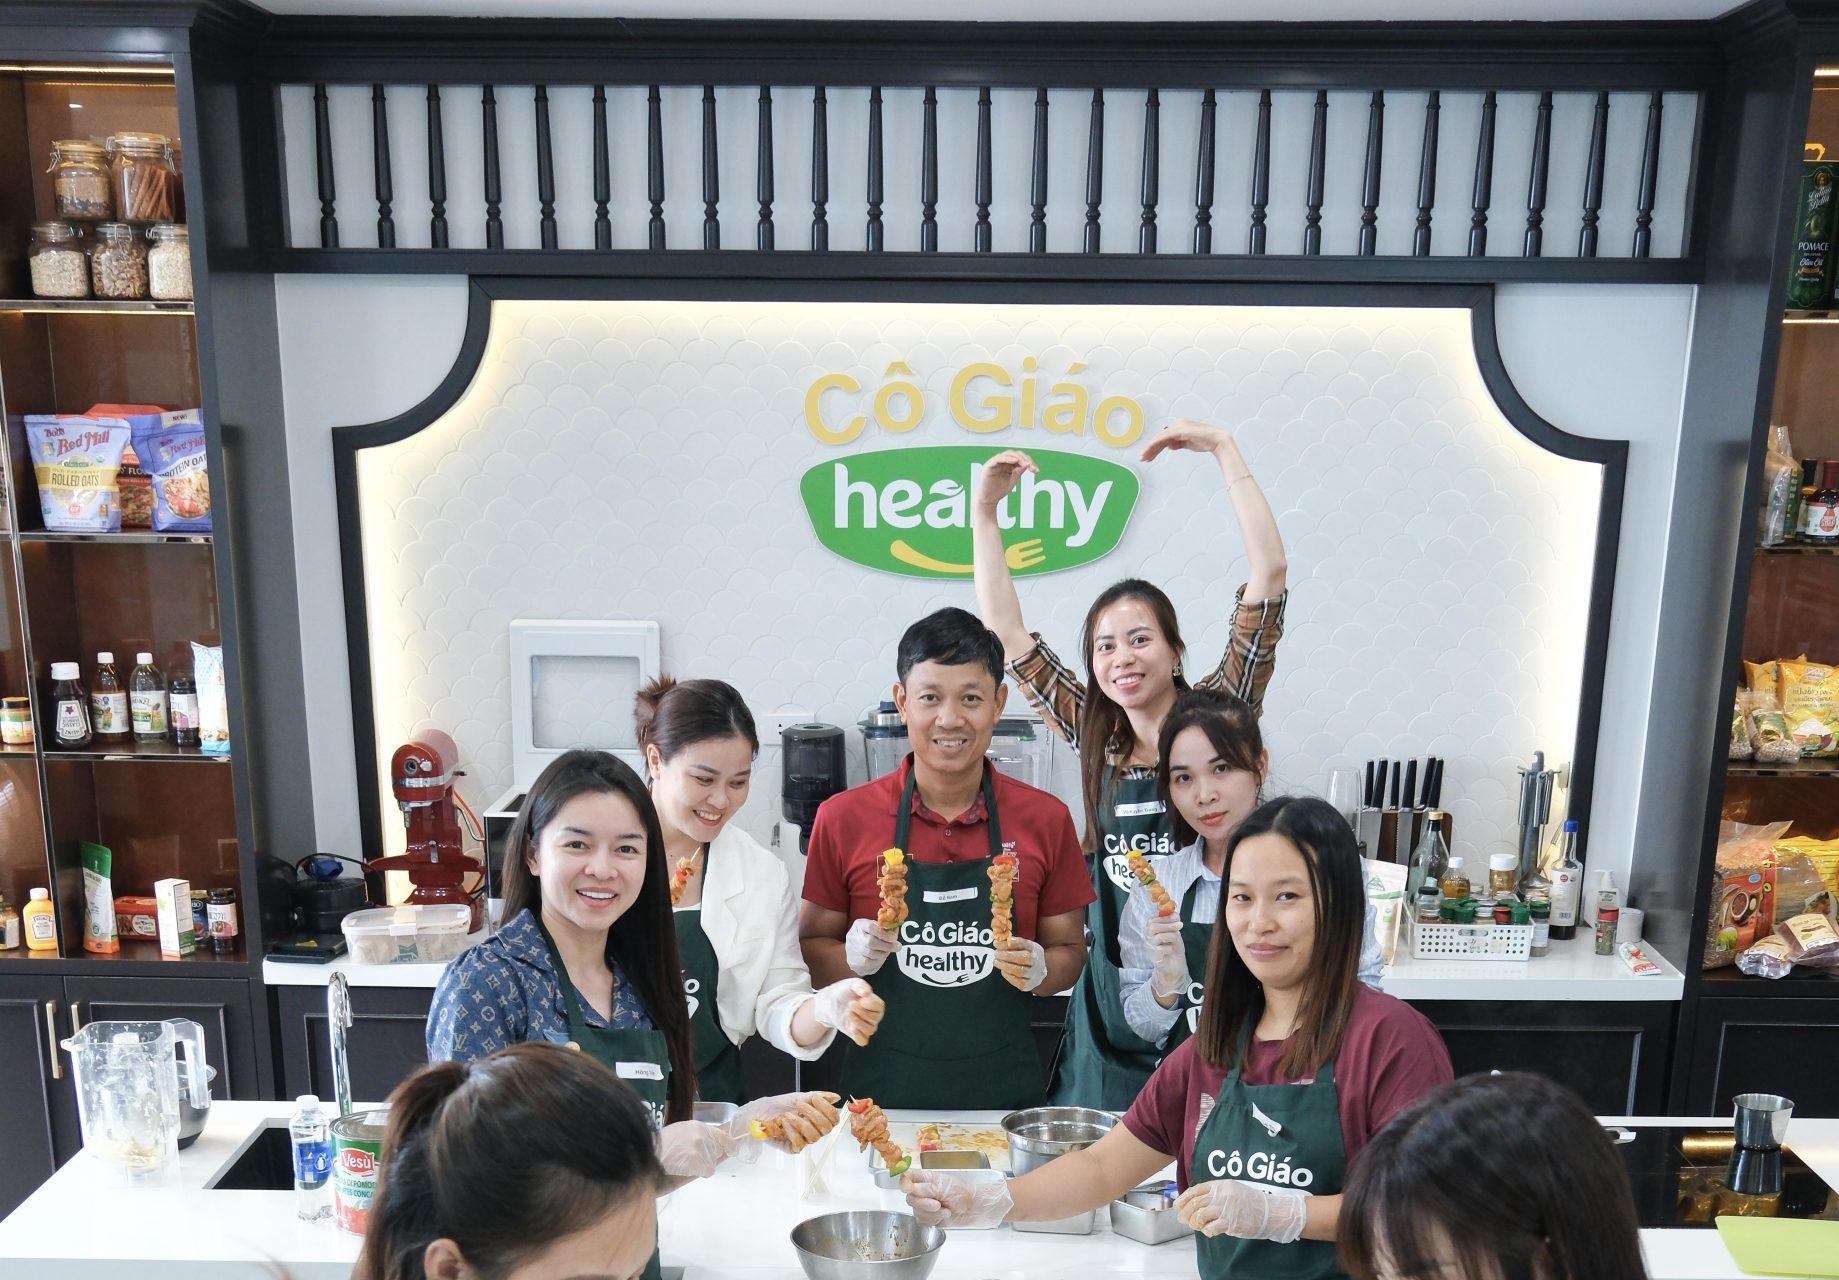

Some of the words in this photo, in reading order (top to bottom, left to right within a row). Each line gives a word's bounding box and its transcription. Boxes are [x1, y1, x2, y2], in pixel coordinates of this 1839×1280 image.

[1798, 242, 1830, 251] POMACE
[803, 360, 925, 446] Cô
[949, 355, 1145, 448] Giáo
[57, 434, 83, 457] Red
[84, 429, 110, 452] Mill
[192, 454, 207, 466] OA
[51, 473, 80, 487] ROLLED
[81, 474, 100, 487] OATS
[1103, 833, 1129, 854] Cô
[900, 920, 936, 944] Cô
[938, 921, 994, 945] Giáo
[905, 947, 988, 974] healthy
[341, 1151, 371, 1169] Vesù
[1207, 1149, 1243, 1177] Cô
[1246, 1151, 1314, 1187] Giáo
[353, 1180, 377, 1188] POMO
